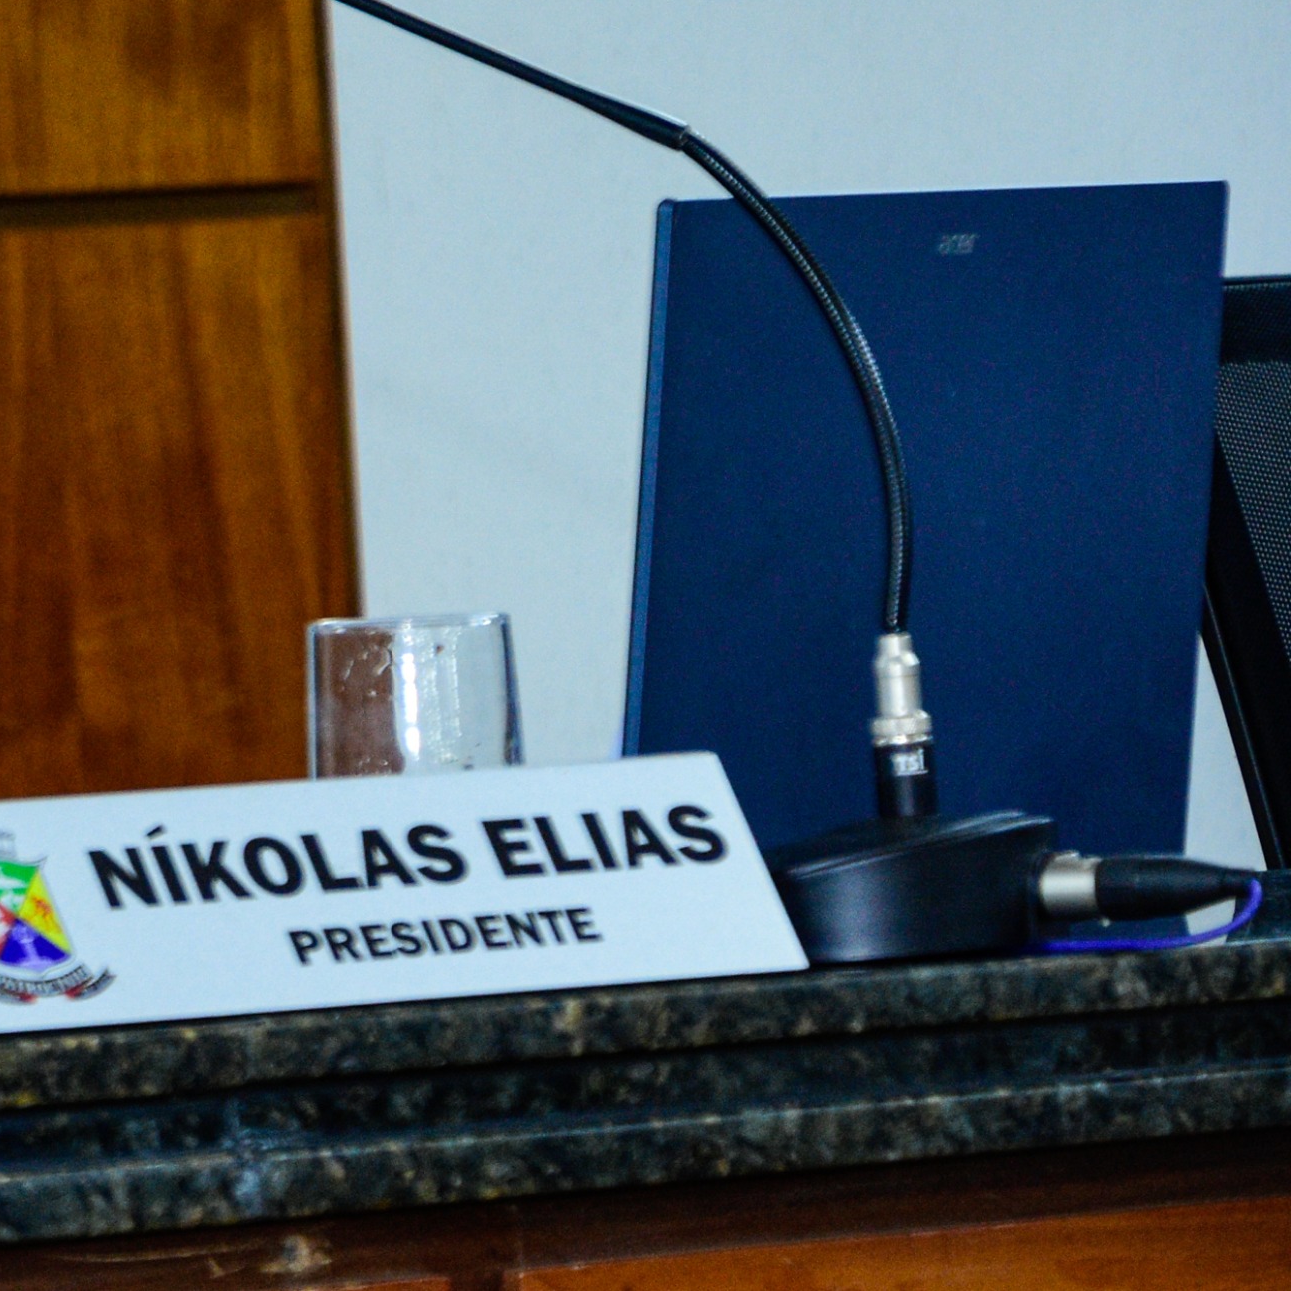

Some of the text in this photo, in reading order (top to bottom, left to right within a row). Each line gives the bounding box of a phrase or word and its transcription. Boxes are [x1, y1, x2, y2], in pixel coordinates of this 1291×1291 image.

[87, 804, 728, 910] NÍKOLAS ELIAS
[287, 906, 602, 966] PRESIDENTE
